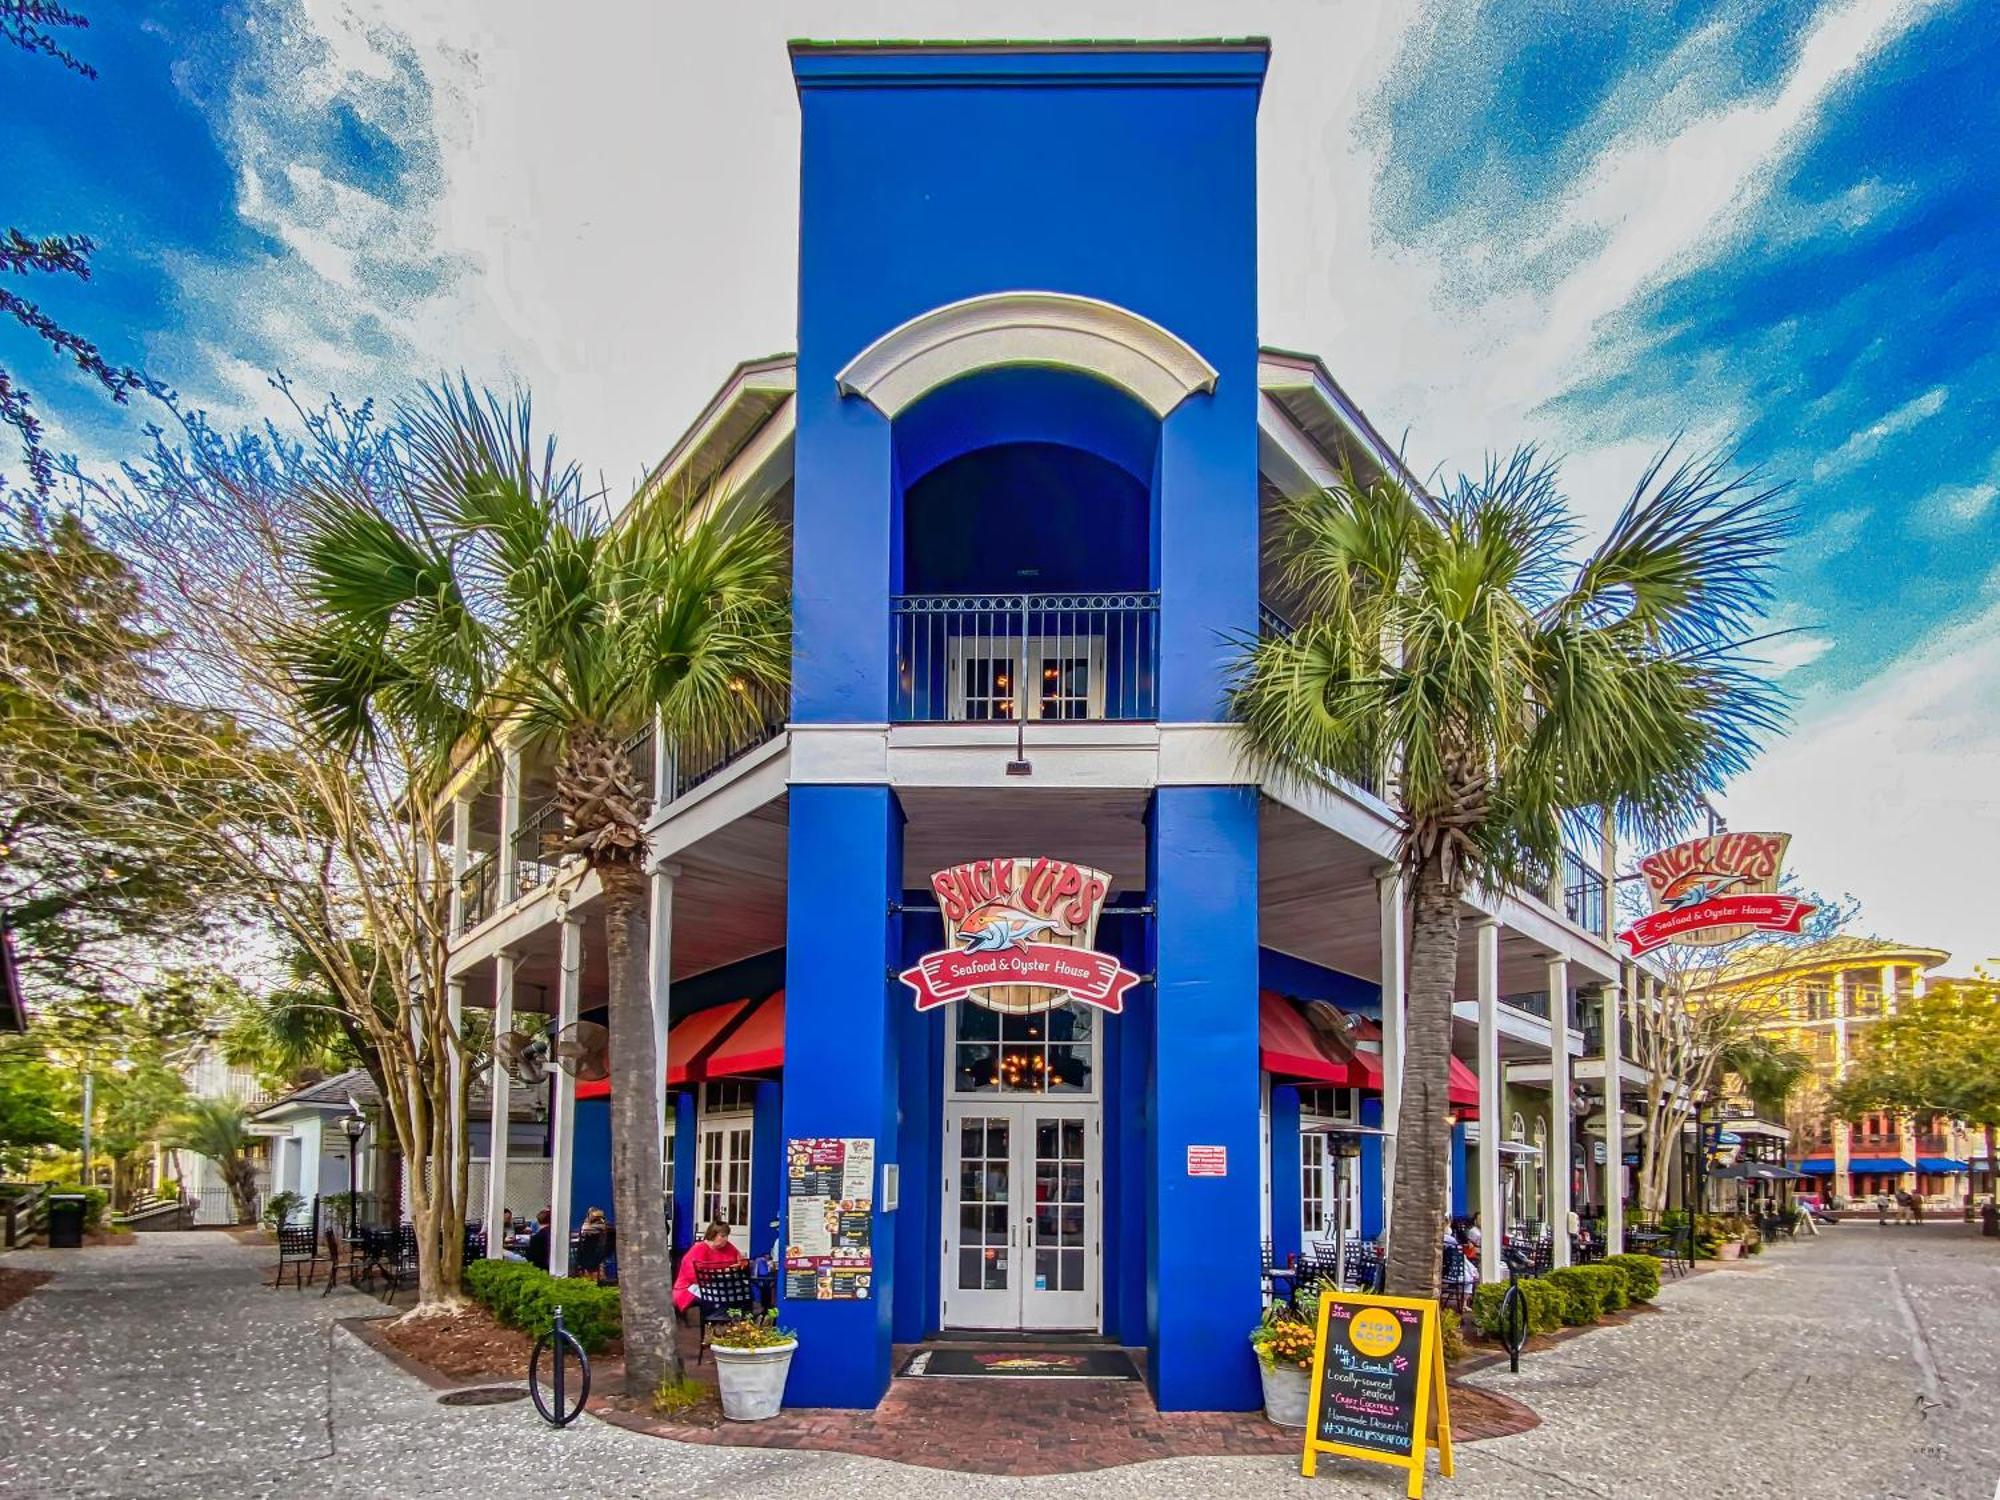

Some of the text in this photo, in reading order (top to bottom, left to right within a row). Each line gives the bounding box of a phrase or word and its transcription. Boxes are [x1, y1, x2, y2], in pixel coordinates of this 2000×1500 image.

[1654, 905, 1773, 932] Seafood & Oyster House
[950, 958, 1090, 979] Seafood & Oyster House
